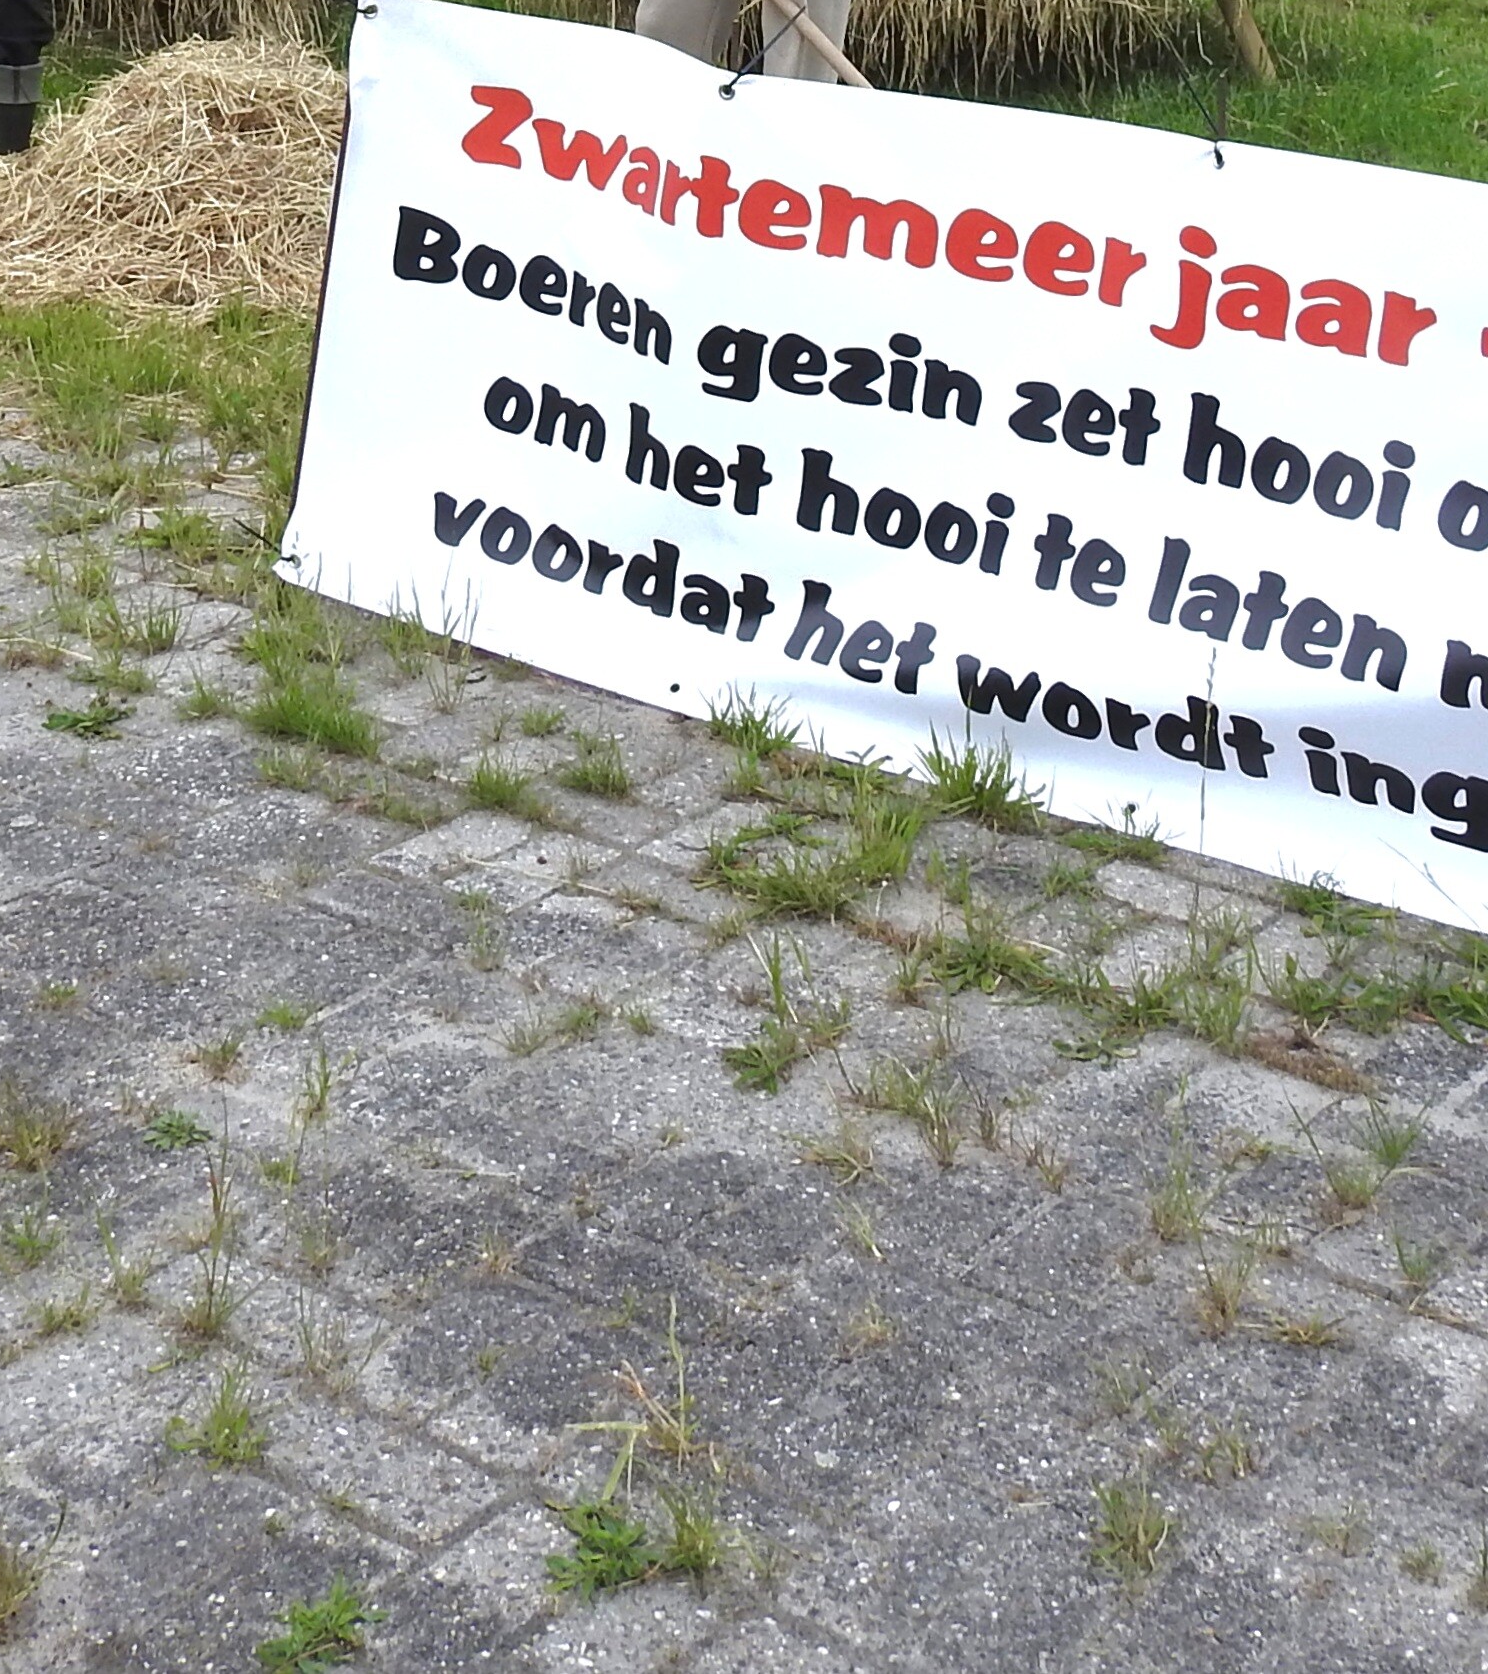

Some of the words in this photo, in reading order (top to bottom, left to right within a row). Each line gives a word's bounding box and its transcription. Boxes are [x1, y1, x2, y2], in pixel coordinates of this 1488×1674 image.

[393, 206, 671, 365] Boeren
[698, 325, 982, 426] gezin
[1009, 382, 1160, 465] zet
[1183, 392, 1415, 531] hooi
[462, 86, 1146, 307] Zwartemeer
[1150, 226, 1436, 366] jaar
[434, 492, 775, 641] voordat
[784, 580, 936, 694] het
[956, 655, 1274, 778] wordt
[484, 377, 606, 462] om
[626, 403, 772, 515] het
[797, 448, 1015, 575] hooi
[1034, 514, 1125, 606] te
[1149, 536, 1407, 692] laten
